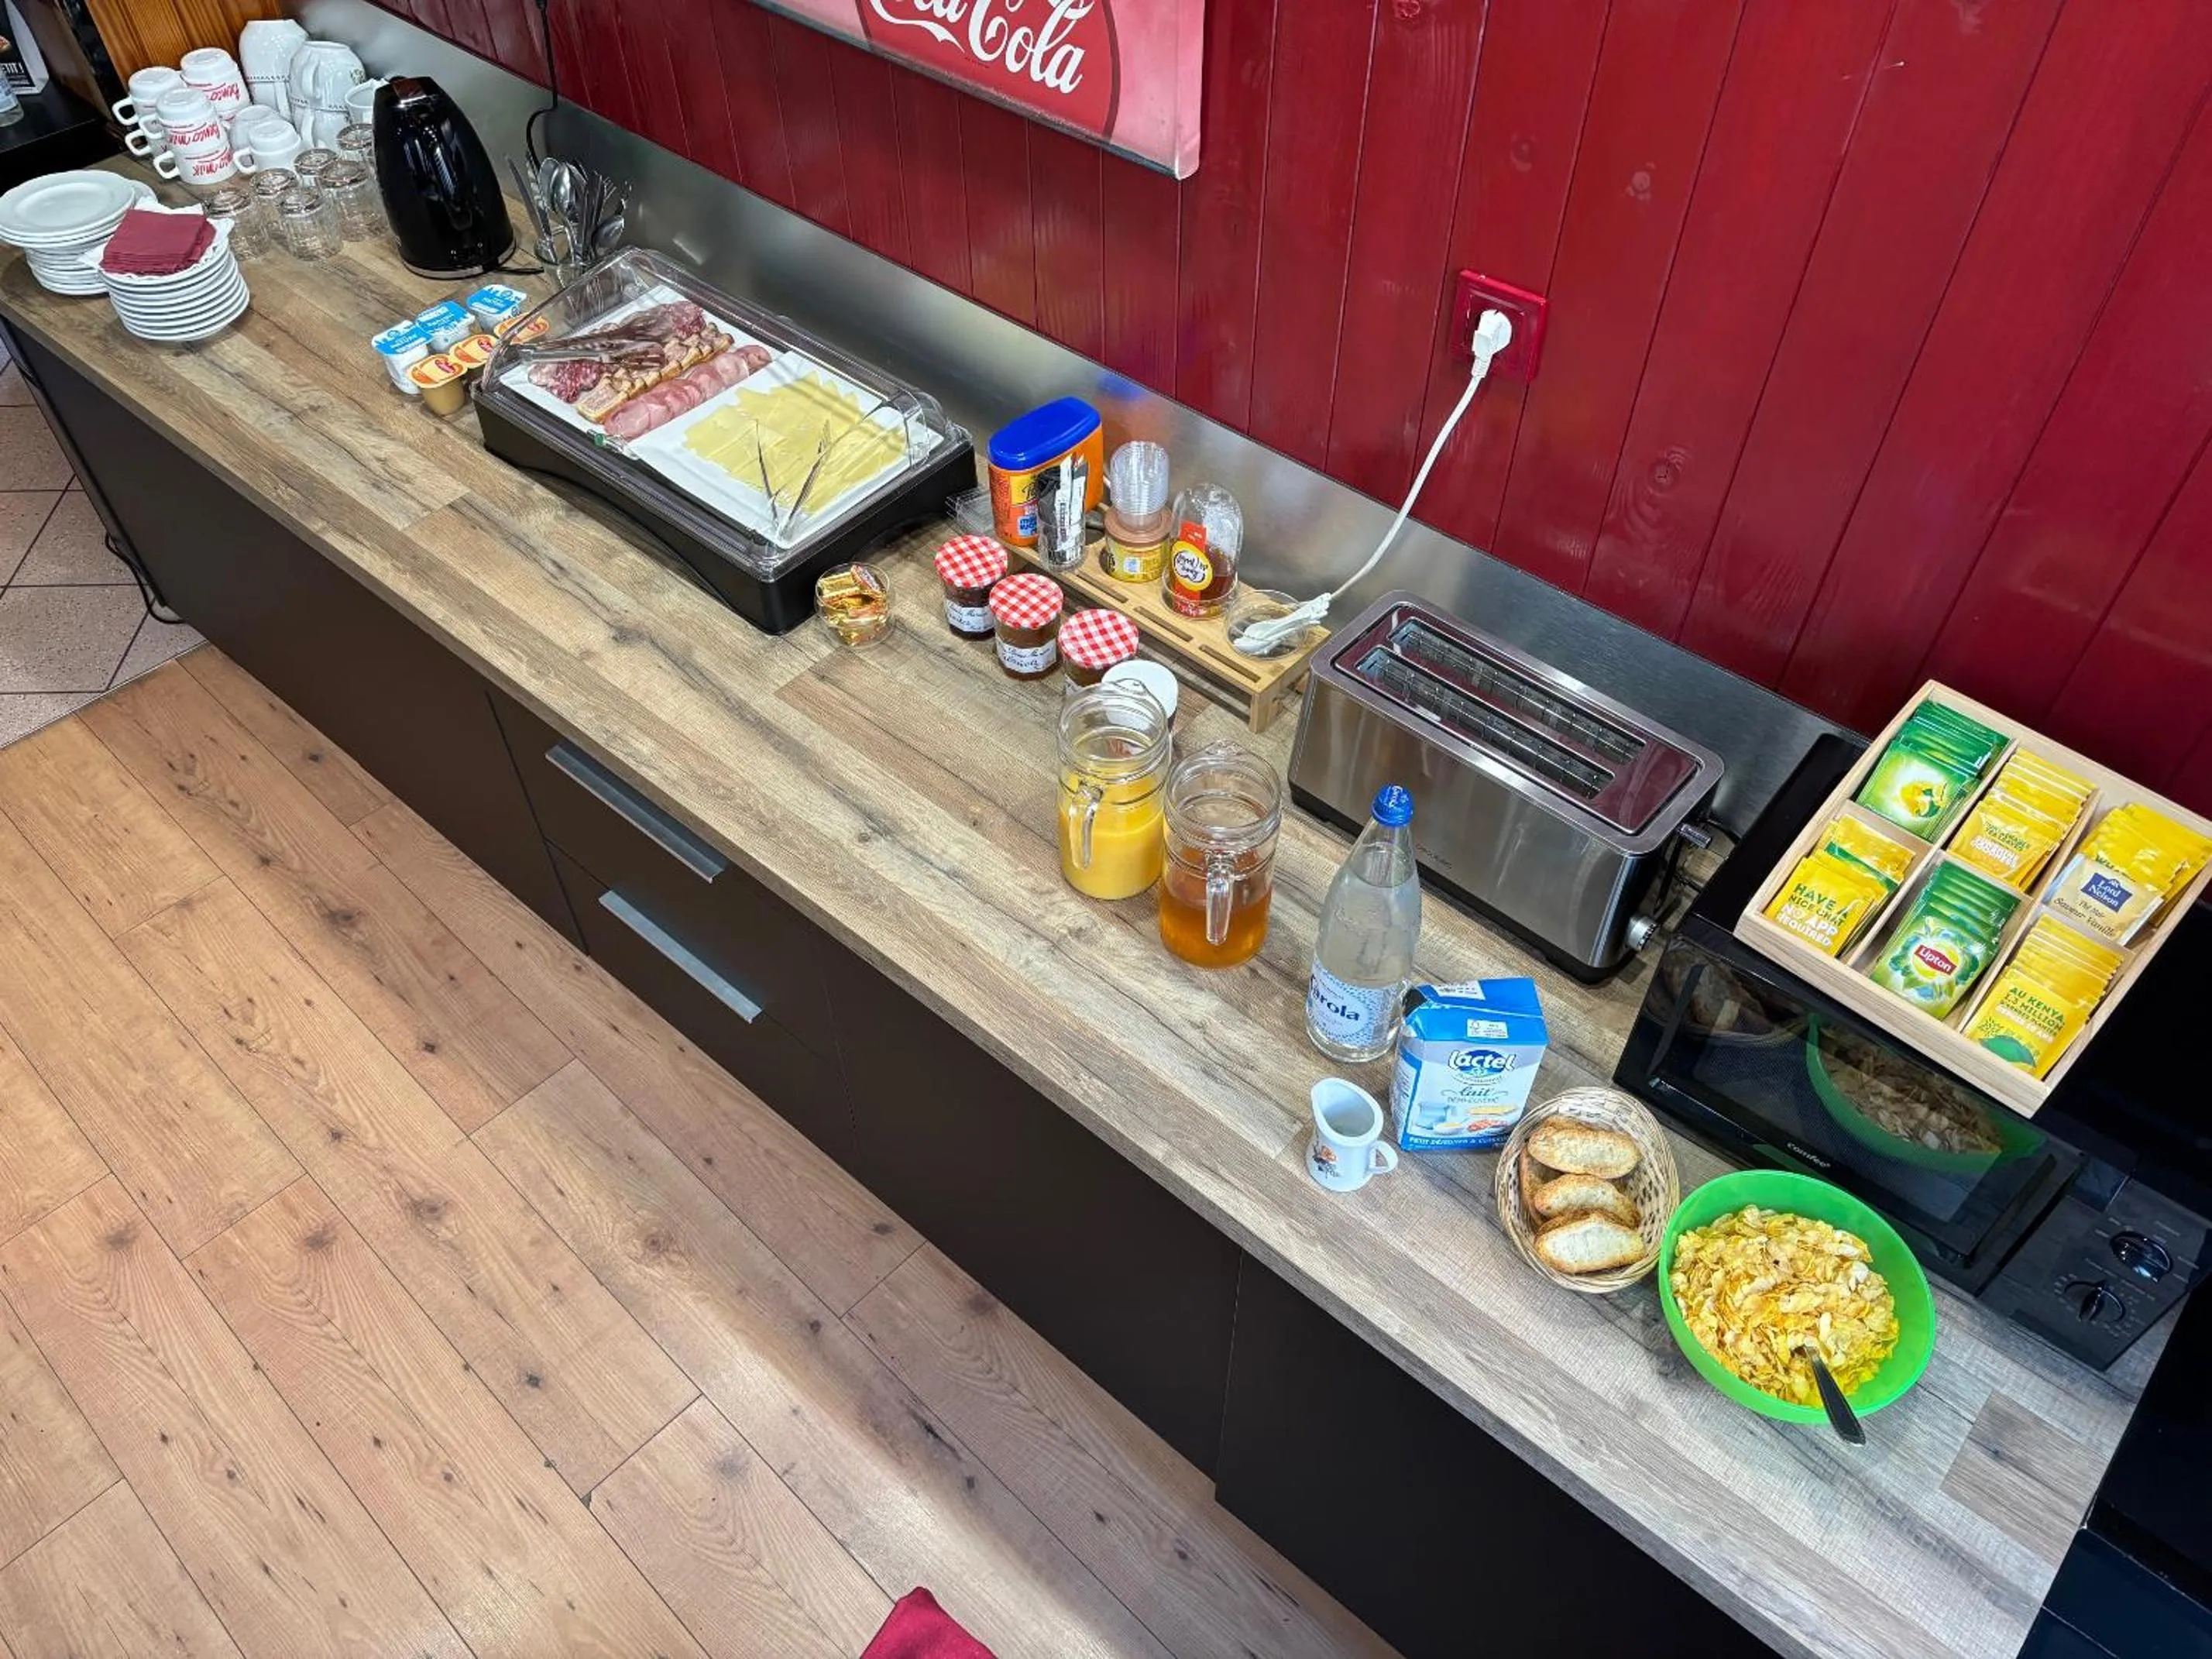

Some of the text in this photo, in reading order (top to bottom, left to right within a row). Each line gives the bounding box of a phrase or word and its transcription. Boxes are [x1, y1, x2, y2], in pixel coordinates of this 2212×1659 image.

[968, 0, 1086, 94] Cola
[1793, 882, 1837, 911] HAVE
[2088, 884, 2119, 908] Nelson
[2097, 879, 2122, 898] Lord
[1788, 894, 1816, 912] NICE
[1805, 915, 1839, 938] APP
[1919, 946, 1952, 973] Lipton
[2008, 987, 2028, 999] AU
[2019, 1001, 2064, 1032] MILLION
[1448, 1049, 1516, 1072] lactel
